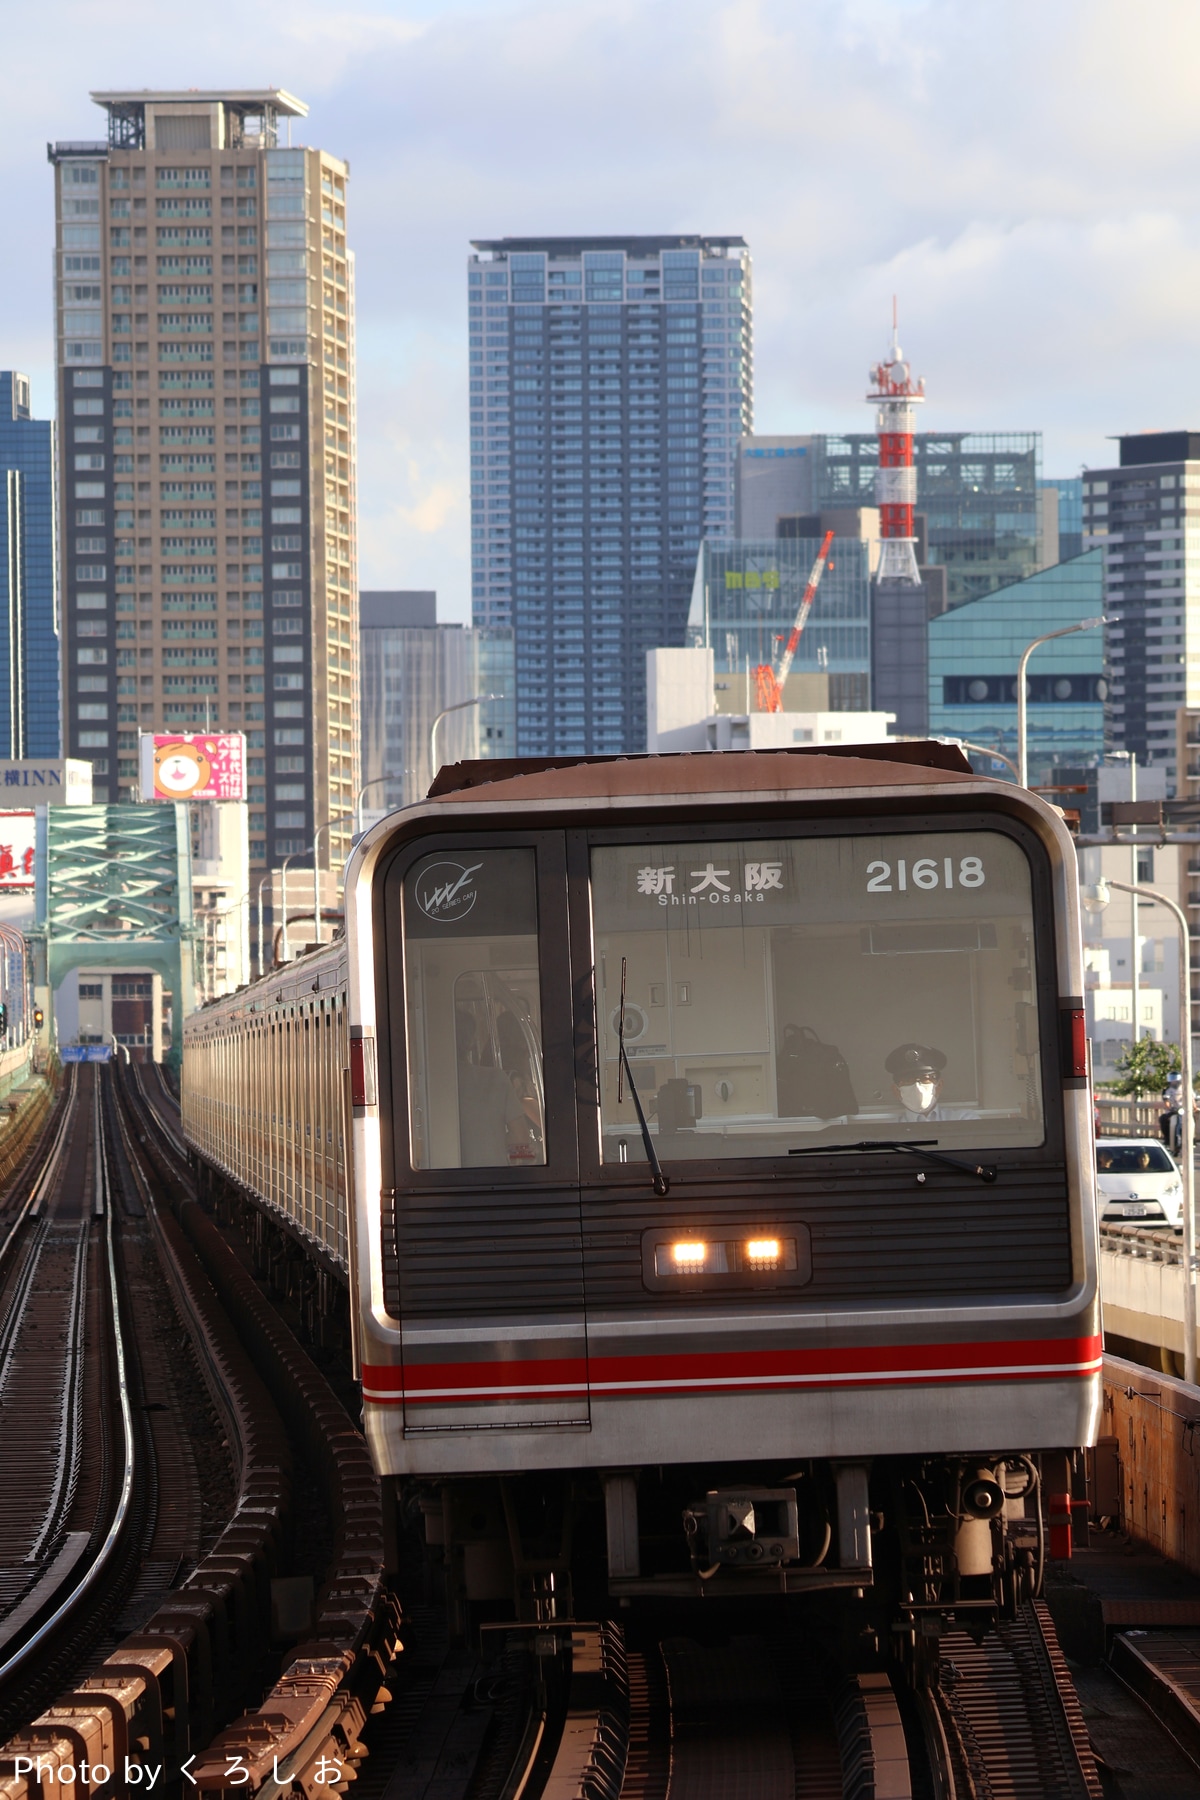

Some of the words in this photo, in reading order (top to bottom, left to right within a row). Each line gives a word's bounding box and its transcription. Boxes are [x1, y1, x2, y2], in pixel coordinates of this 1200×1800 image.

[0, 769, 61, 787] 横INN
[637, 862, 784, 895] 新大阪
[866, 856, 986, 892] 21618
[462, 891, 474, 901] CAR
[658, 891, 765, 906] Shin-Osaka
